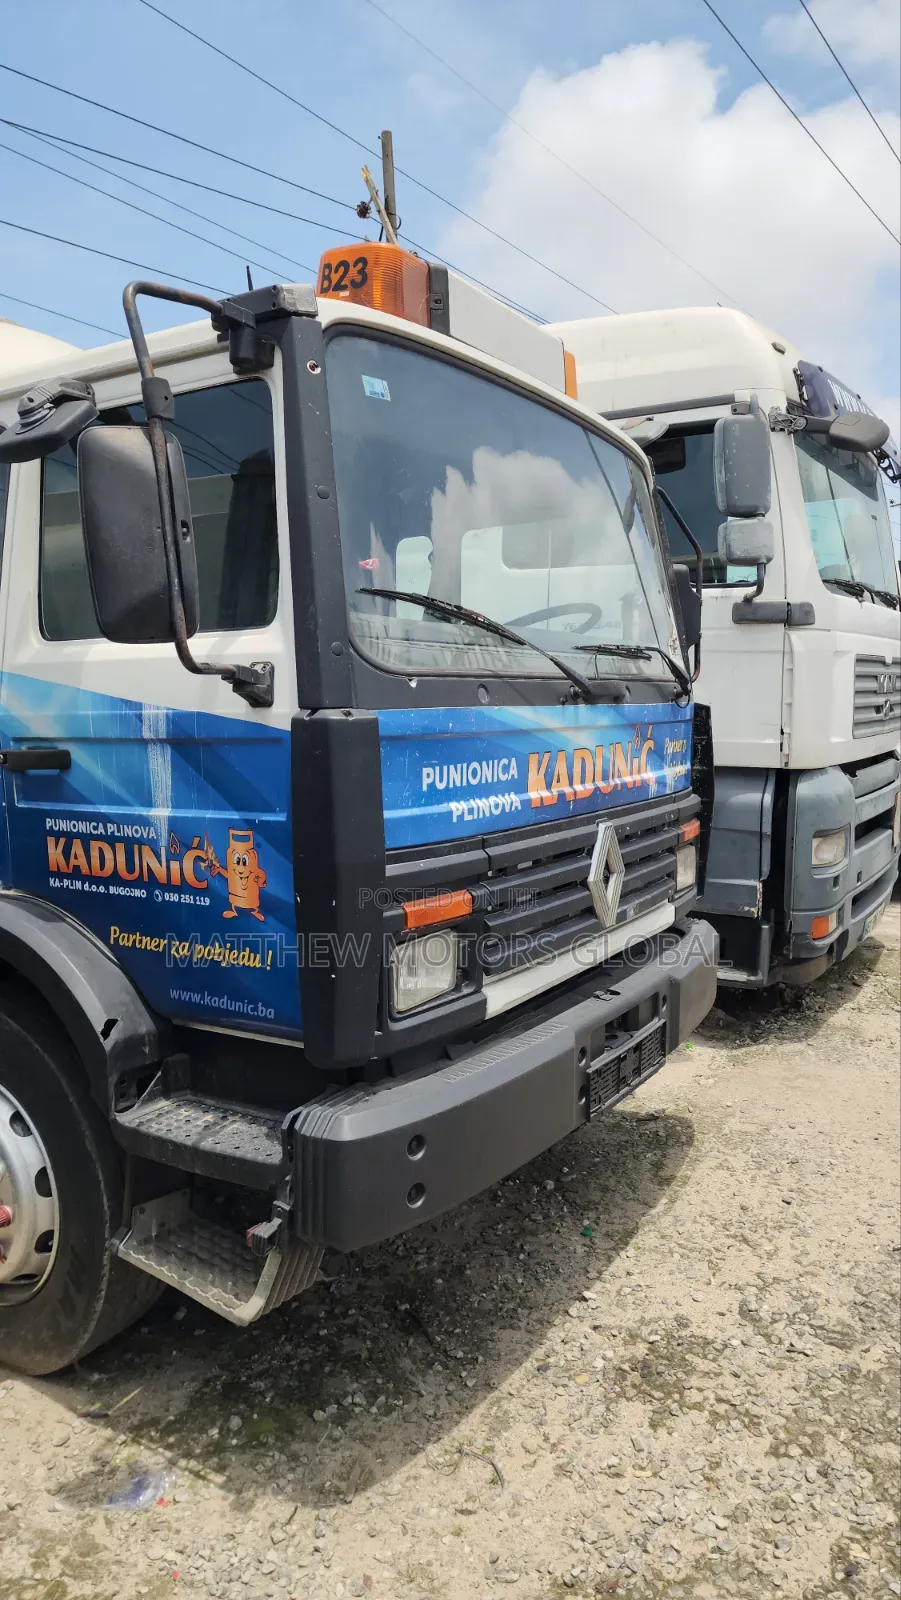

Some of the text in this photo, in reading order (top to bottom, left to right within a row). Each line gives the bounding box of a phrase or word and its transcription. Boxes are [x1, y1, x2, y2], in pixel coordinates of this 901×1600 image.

[320, 256, 369, 294] B23
[422, 757, 518, 792] PUNIONICA
[451, 791, 521, 823] PLINOVA
[45, 818, 157, 839] PUNIONICA PLINOVA
[49, 877, 210, 906] KA-PLIN d.o.o. BUGOJNO 030 251 119
[110, 926, 167, 952] Partner
[171, 941, 190, 958] za
[194, 941, 261, 967] pobjedu
[169, 988, 275, 1019] www.kadunic.ba
